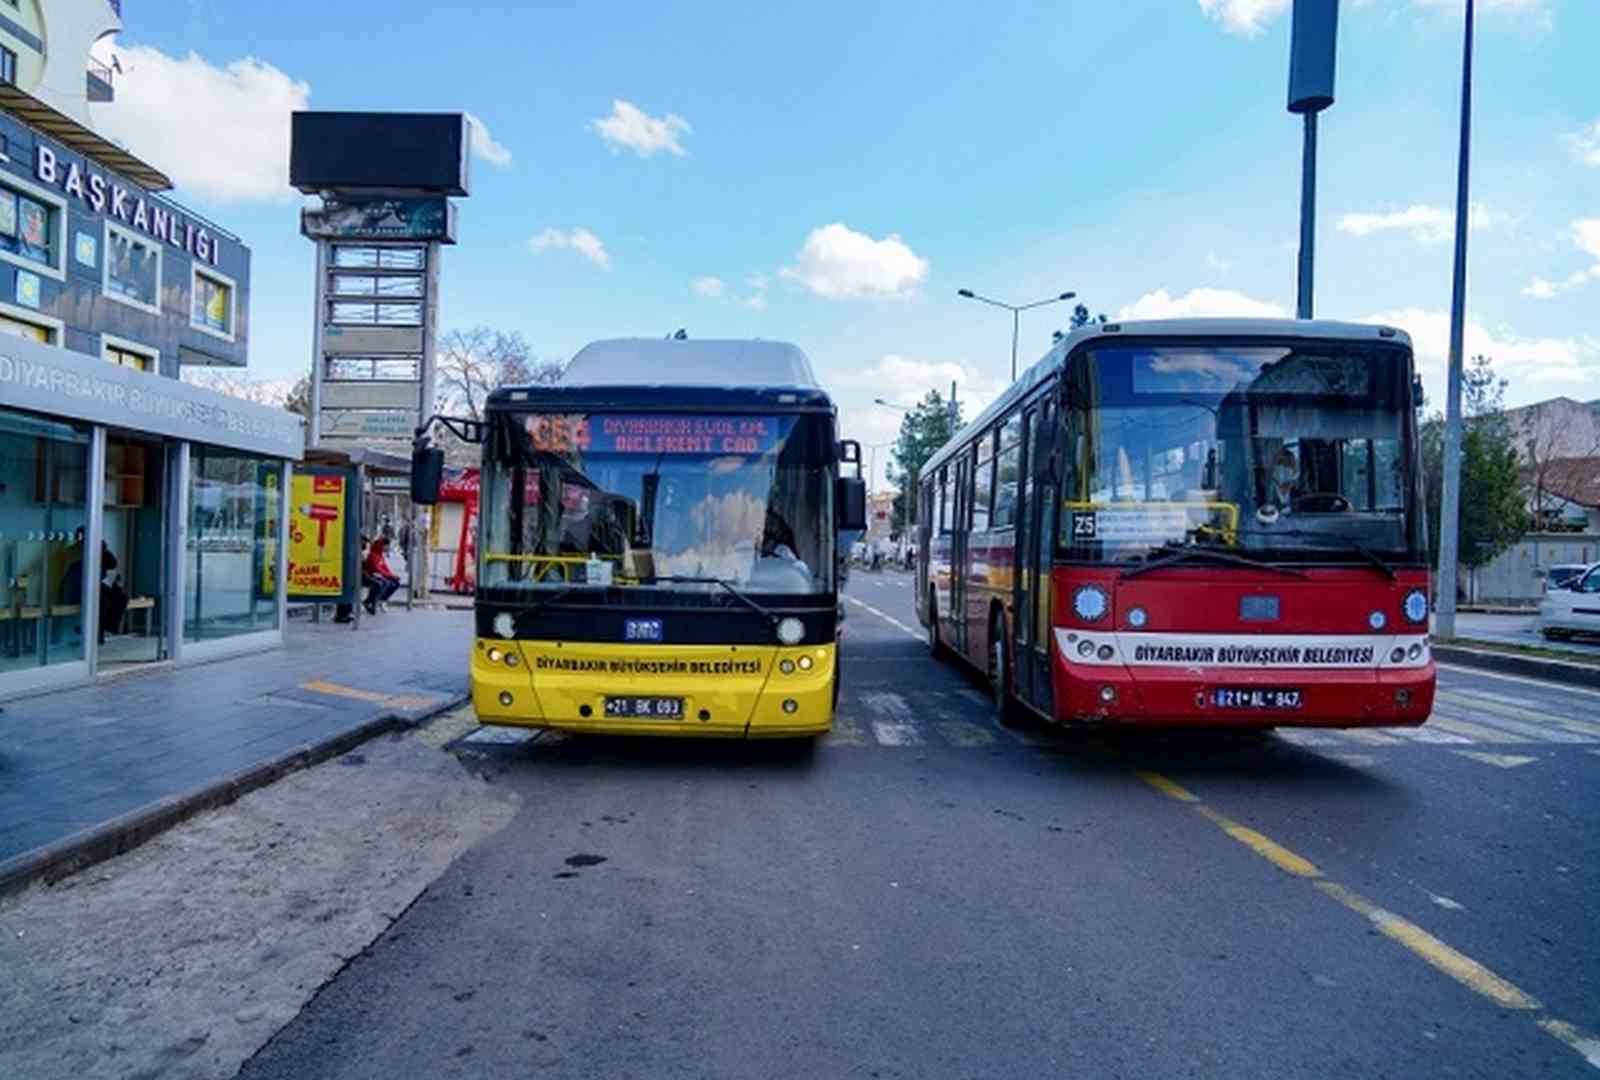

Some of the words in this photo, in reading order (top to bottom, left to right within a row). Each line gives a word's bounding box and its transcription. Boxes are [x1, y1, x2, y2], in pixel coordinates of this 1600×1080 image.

[37, 146, 219, 265] BAŞKANLIĞI
[1074, 516, 1094, 534] 25
[1135, 643, 1214, 662] DİYARBAKIR
[1217, 644, 1301, 665] BÜYÜKŞEHİR
[1302, 644, 1375, 664] BELEDİYESİ
[536, 656, 607, 671] DİYARBAKIR
[690, 658, 761, 674] BELEDİYESİ
